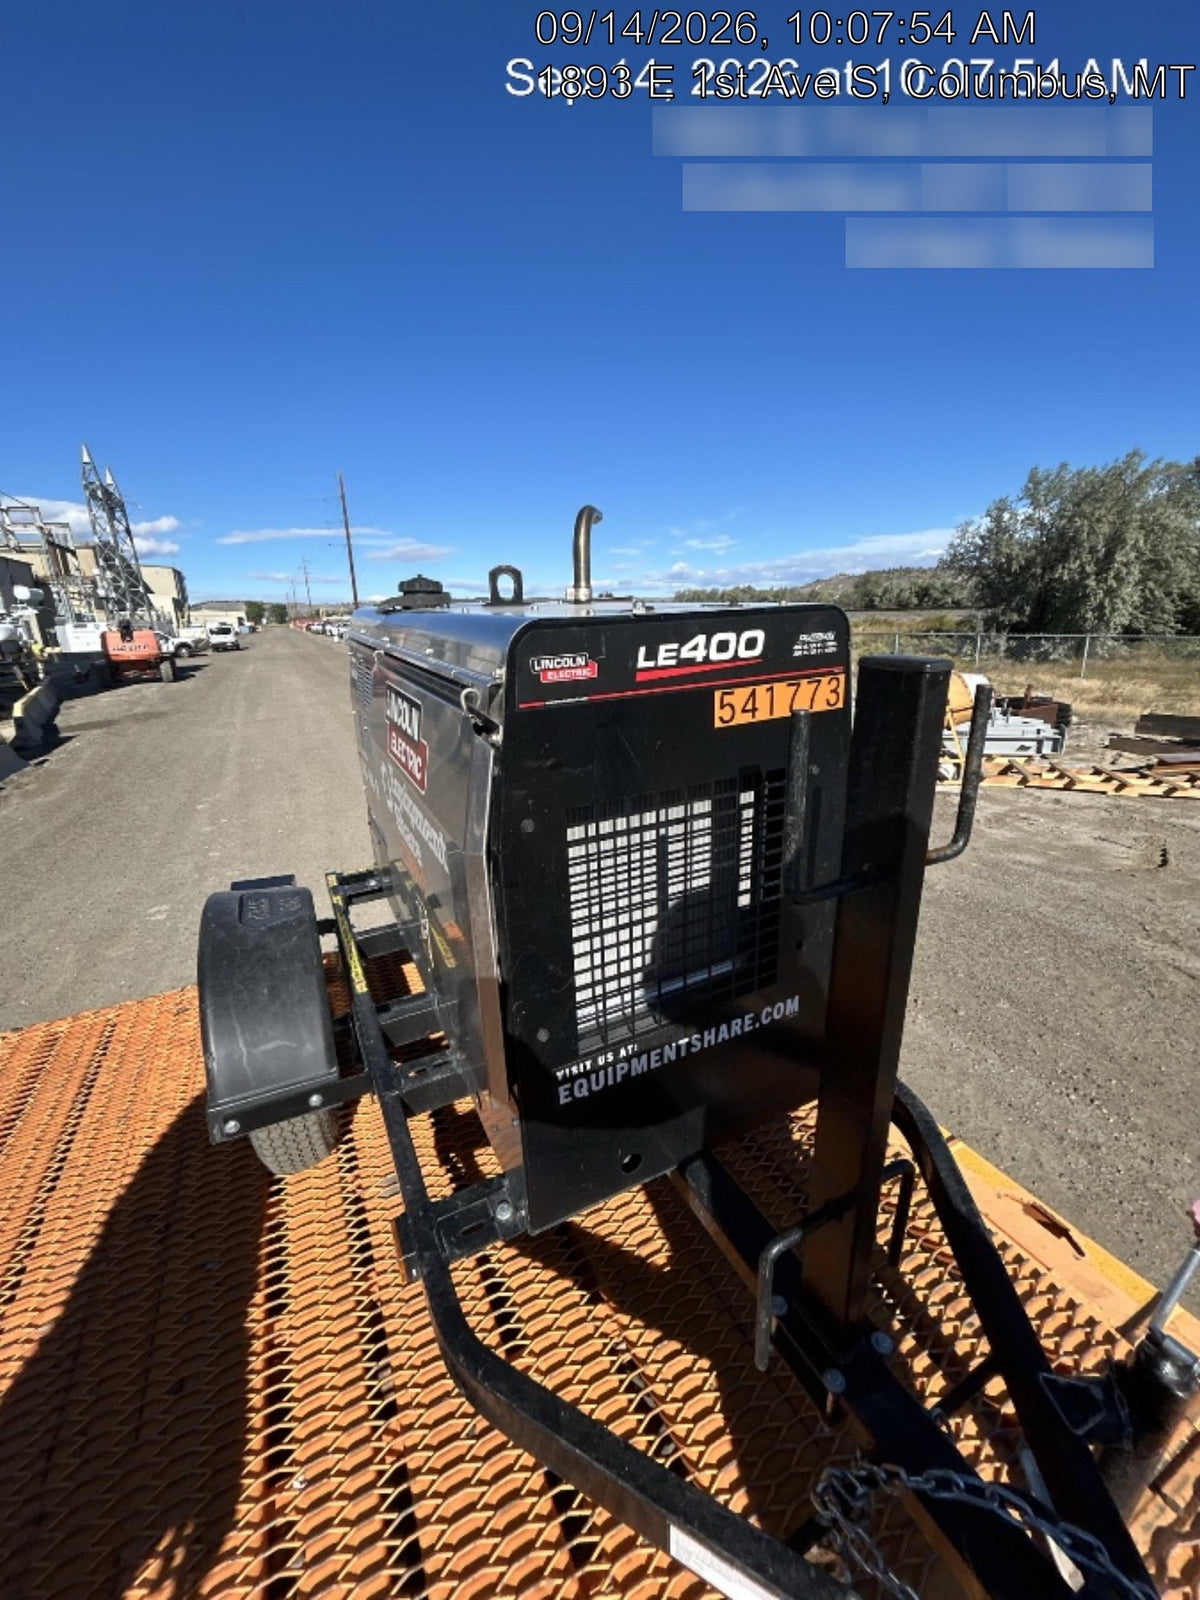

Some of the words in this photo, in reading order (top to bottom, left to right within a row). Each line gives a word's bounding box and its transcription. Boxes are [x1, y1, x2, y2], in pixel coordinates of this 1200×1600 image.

[533, 655, 586, 671] LINCOLN
[635, 628, 765, 669] LE400
[547, 668, 593, 680] ELECTRIC
[716, 676, 842, 725] 541773
[391, 731, 423, 781] ELECTRIC
[555, 1060, 592, 1081] VISIT
[597, 1051, 614, 1066] US
[558, 995, 801, 1106] EQUIPMENTSHARE.COM
